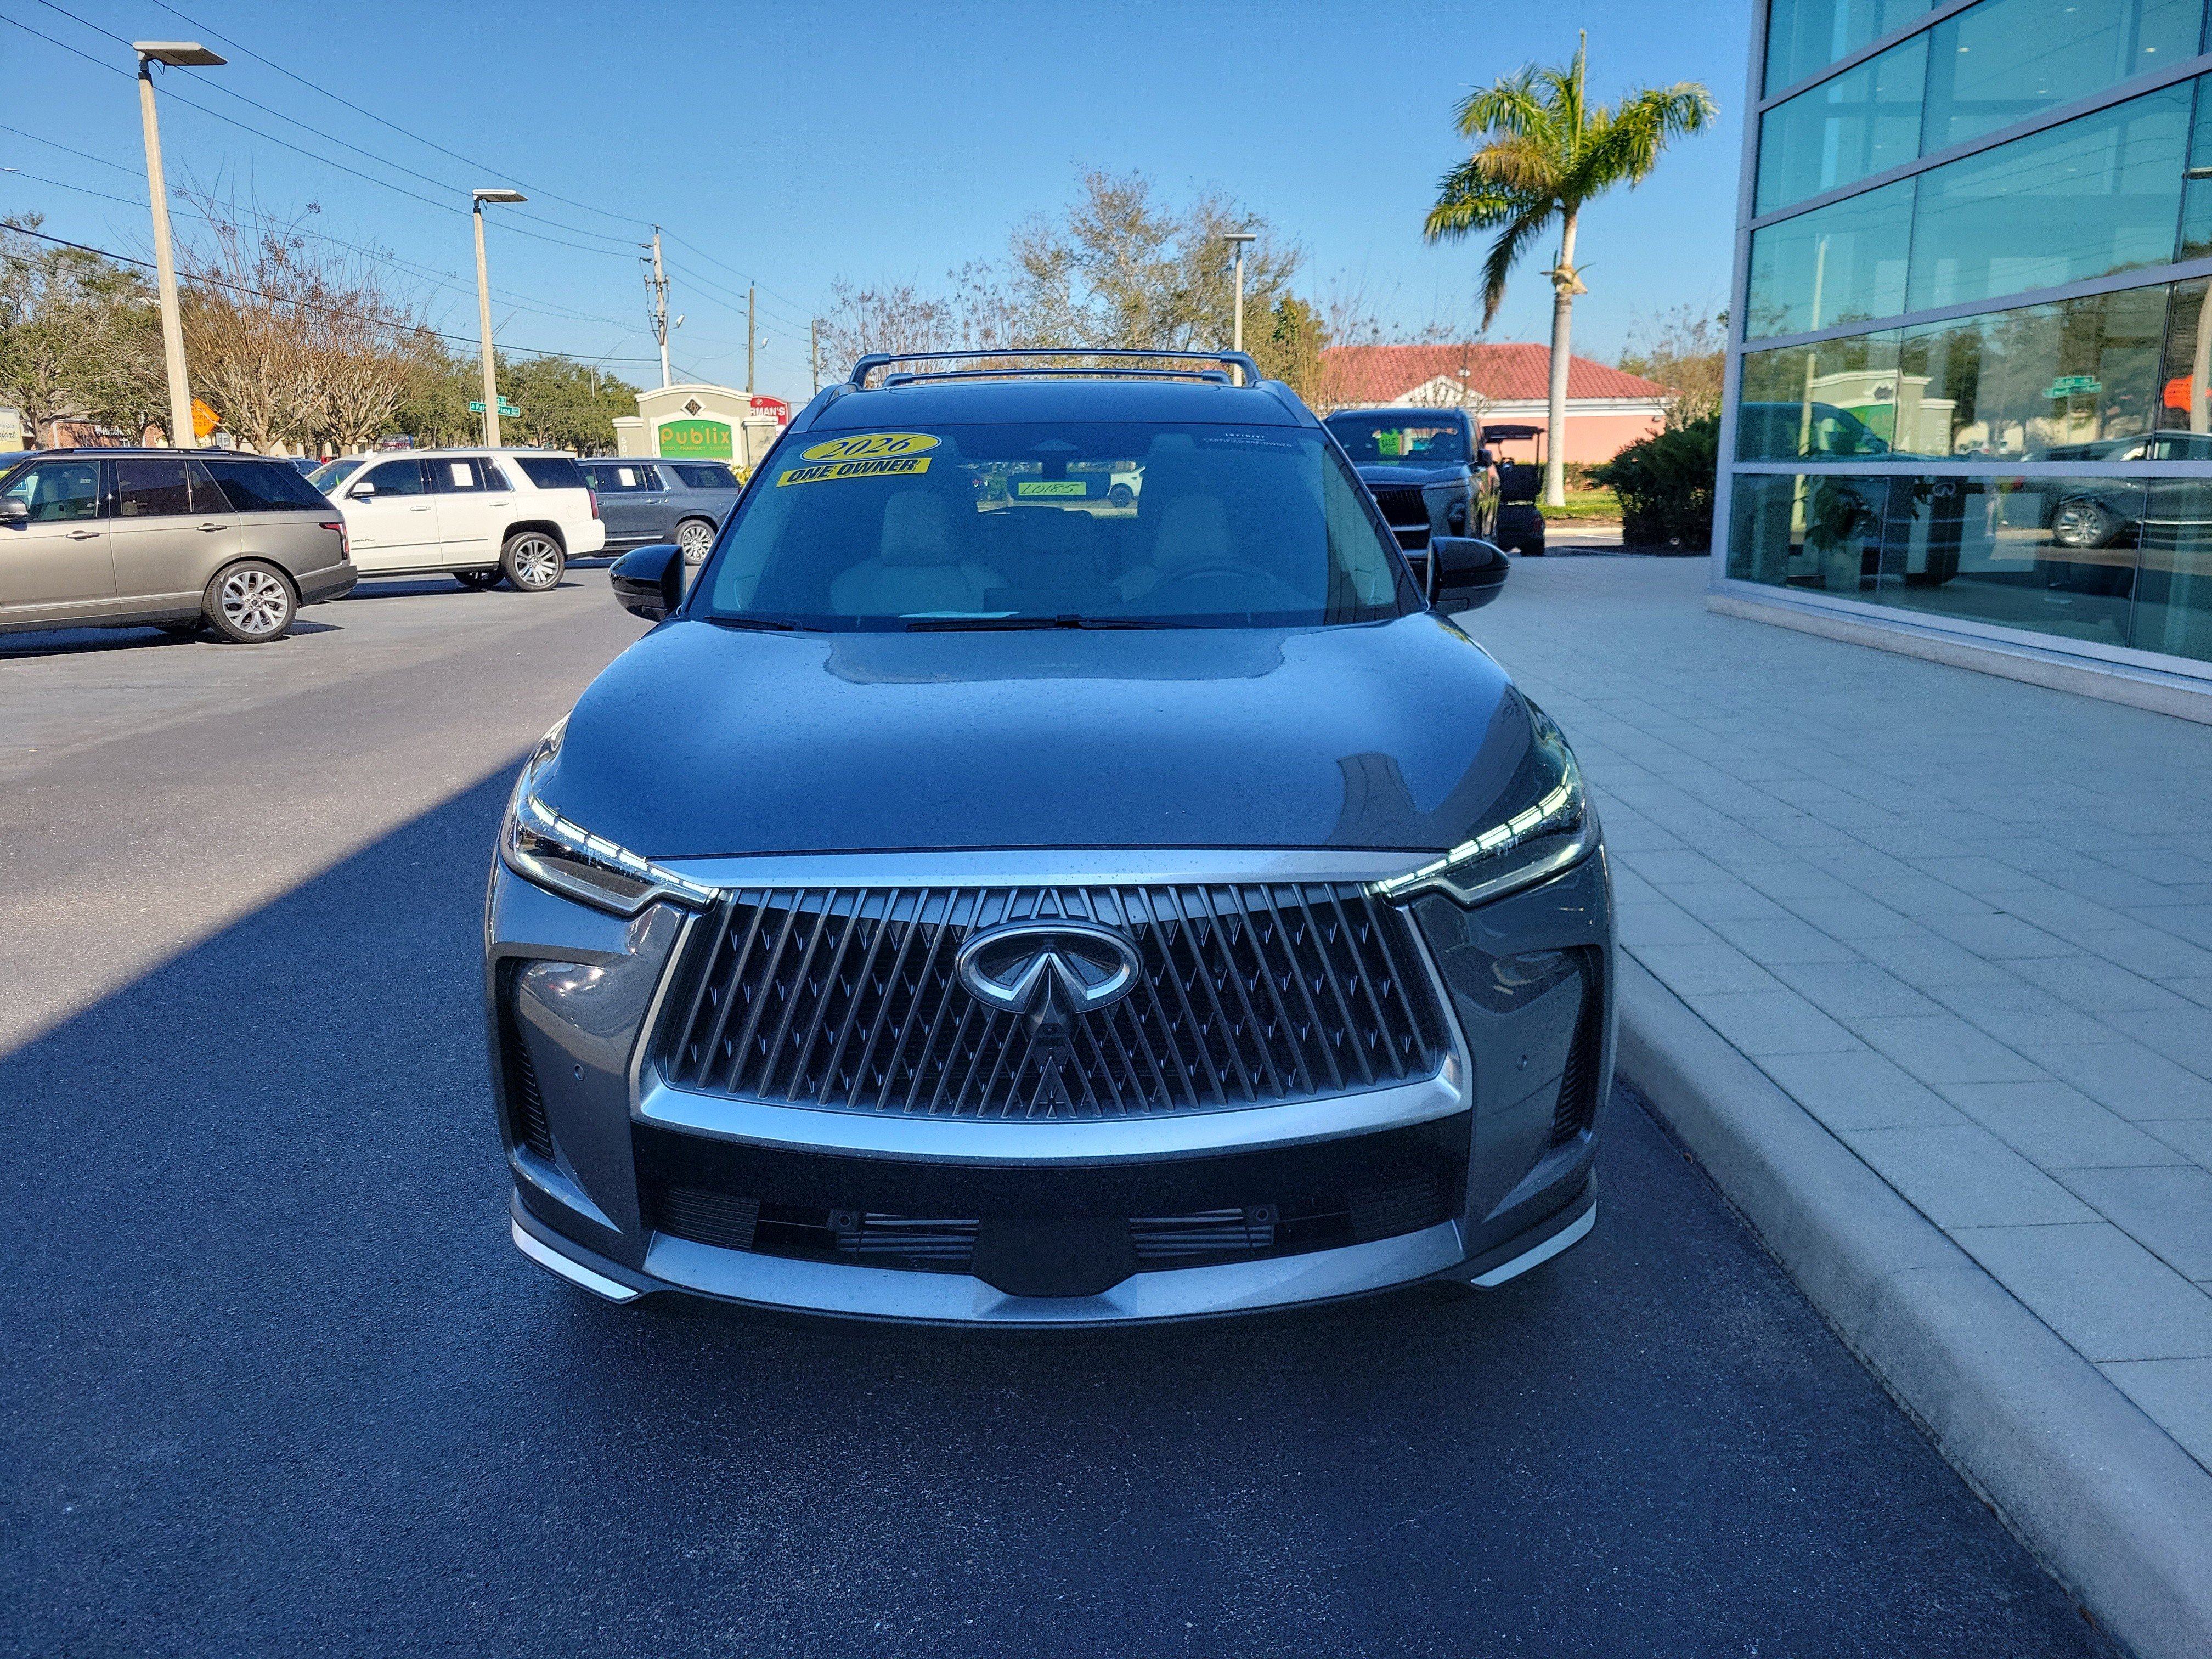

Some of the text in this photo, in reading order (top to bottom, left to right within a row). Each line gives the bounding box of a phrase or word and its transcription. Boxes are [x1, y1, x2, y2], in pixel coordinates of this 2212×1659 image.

[750, 407, 785, 416] RMAN'S
[661, 427, 730, 445] Publix
[817, 436, 919, 459] 2026
[787, 459, 919, 483] ONE OWNER
